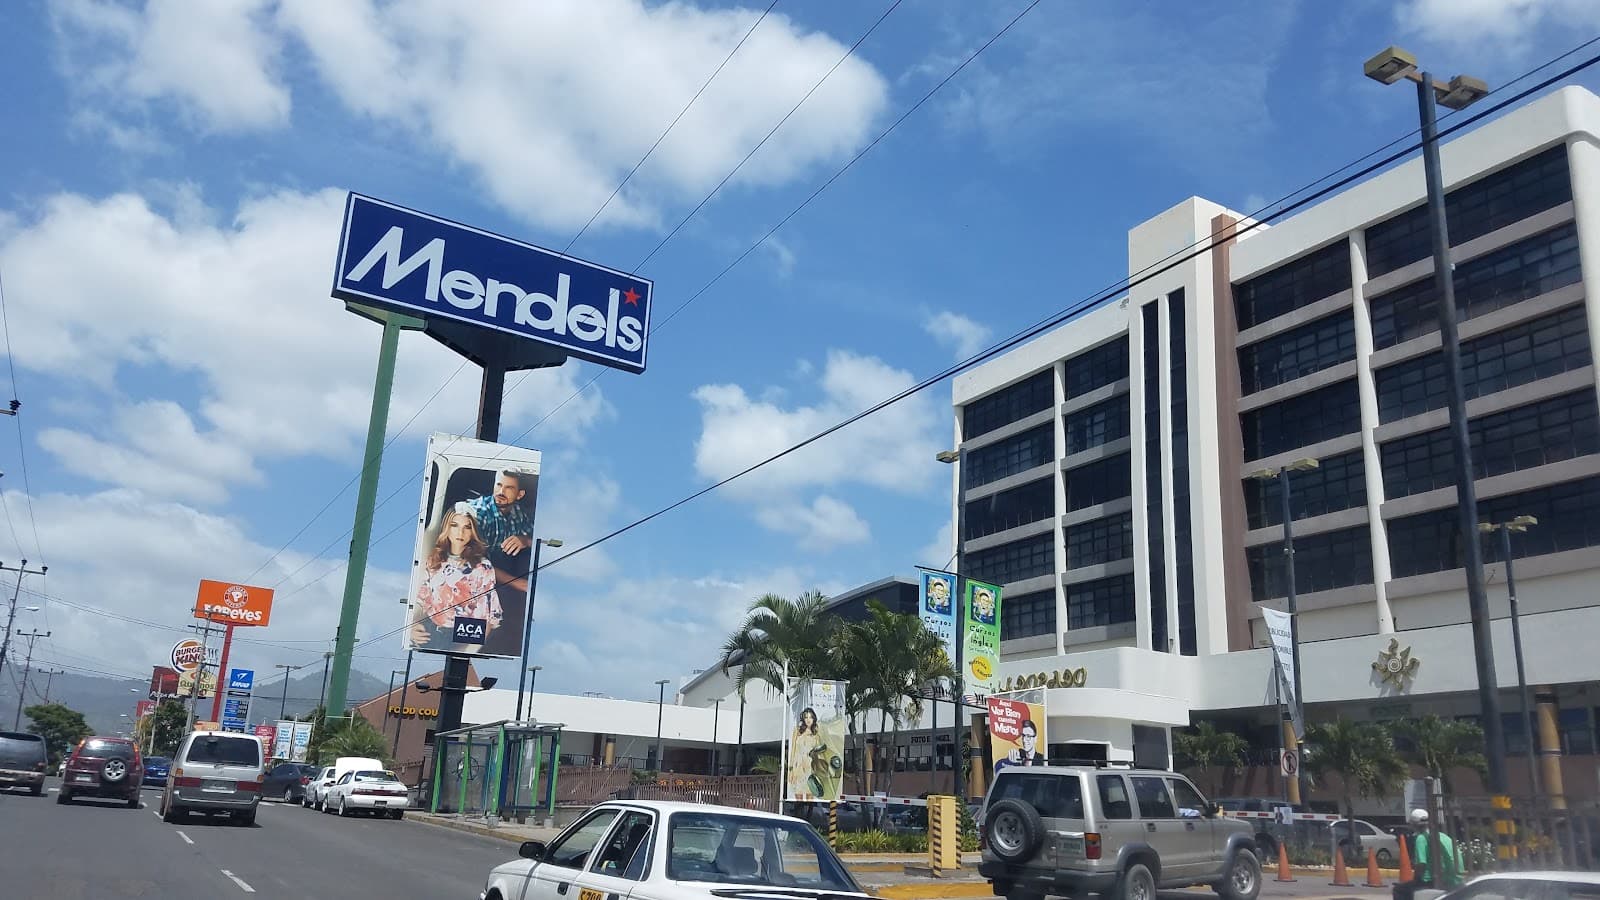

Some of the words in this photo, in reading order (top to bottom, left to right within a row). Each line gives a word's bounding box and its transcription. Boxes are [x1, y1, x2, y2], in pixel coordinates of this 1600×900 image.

[456, 623, 483, 635] ACA
[175, 647, 205, 657] BURGE
[388, 705, 416, 715] FOOD
[418, 708, 438, 717] COU
